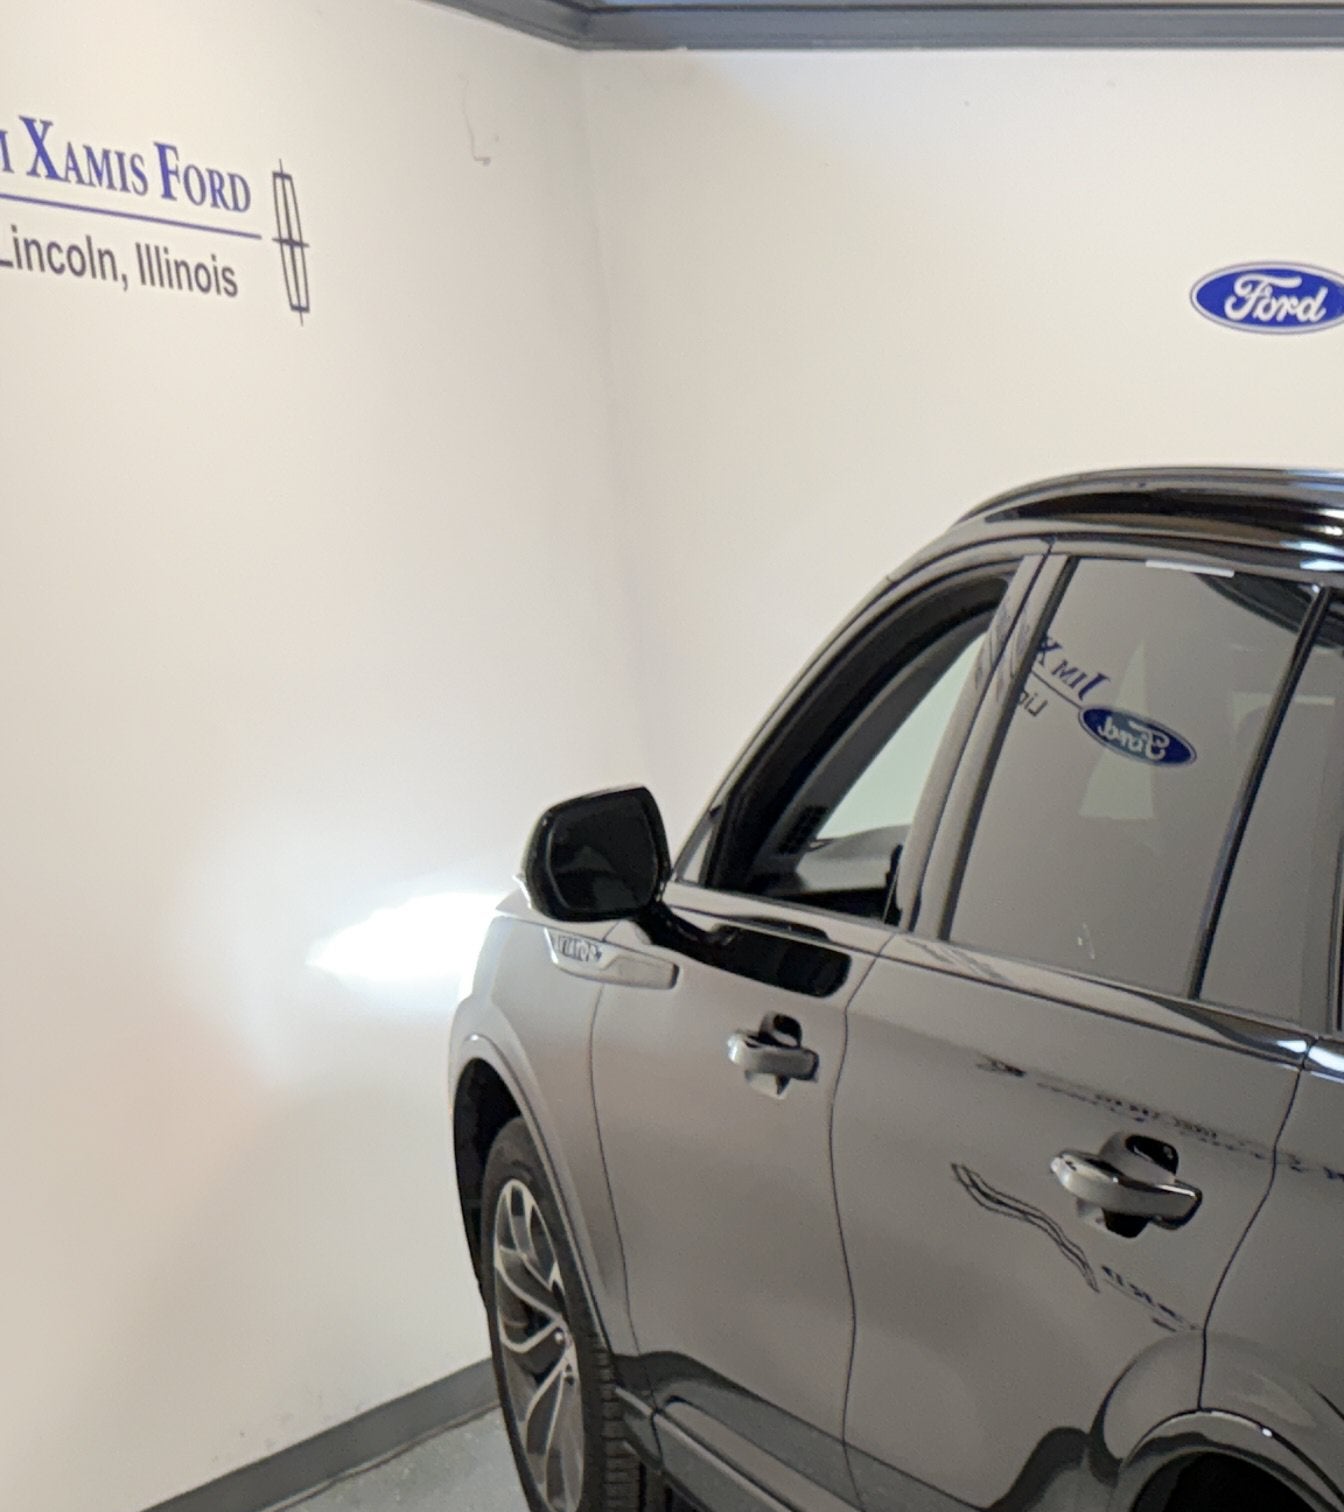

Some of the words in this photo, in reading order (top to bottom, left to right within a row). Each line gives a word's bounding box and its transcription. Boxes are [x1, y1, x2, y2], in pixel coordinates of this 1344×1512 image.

[19, 114, 149, 198] XAMIS
[153, 141, 252, 214] FORD
[134, 241, 239, 298] Illinois
[1223, 272, 1329, 323] Ford
